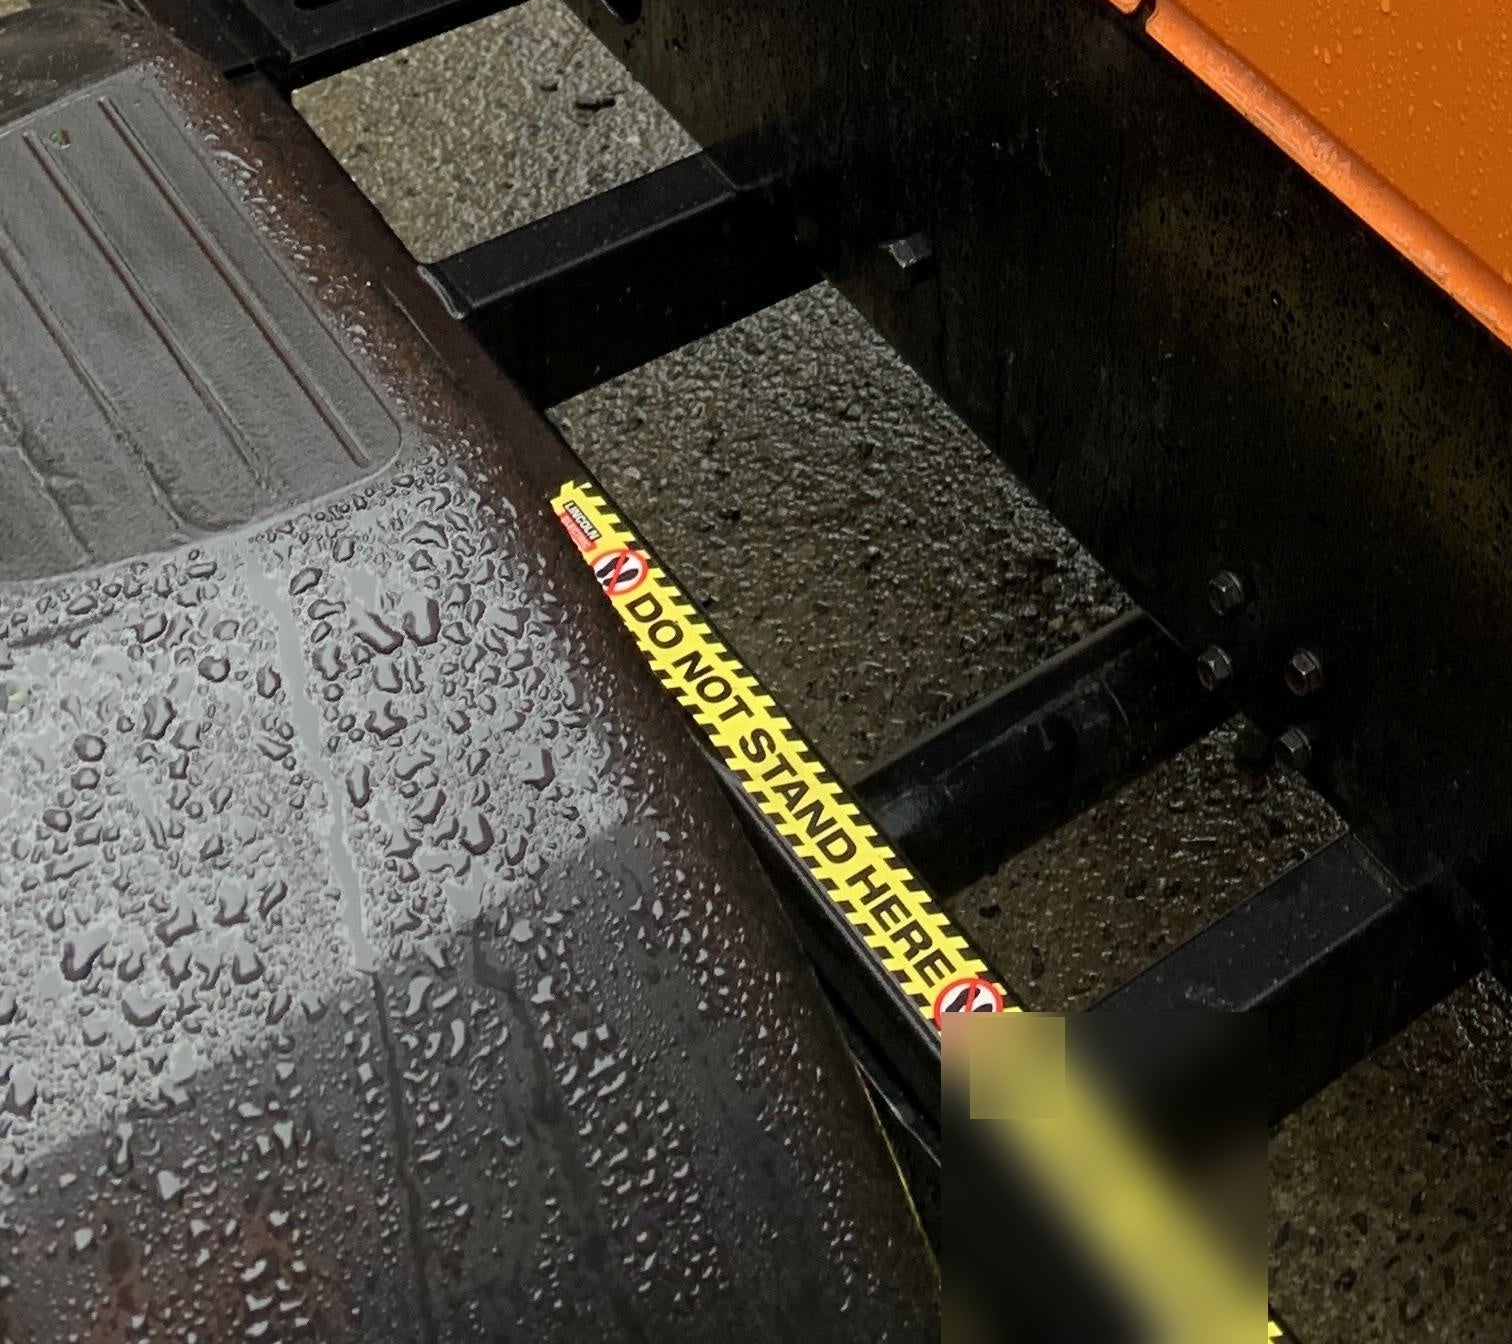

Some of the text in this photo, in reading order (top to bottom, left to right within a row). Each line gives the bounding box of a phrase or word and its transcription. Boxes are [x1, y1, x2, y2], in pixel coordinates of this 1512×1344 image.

[564, 501, 600, 542] LINCOLN
[625, 592, 957, 987] DO NOT STAND HERE
